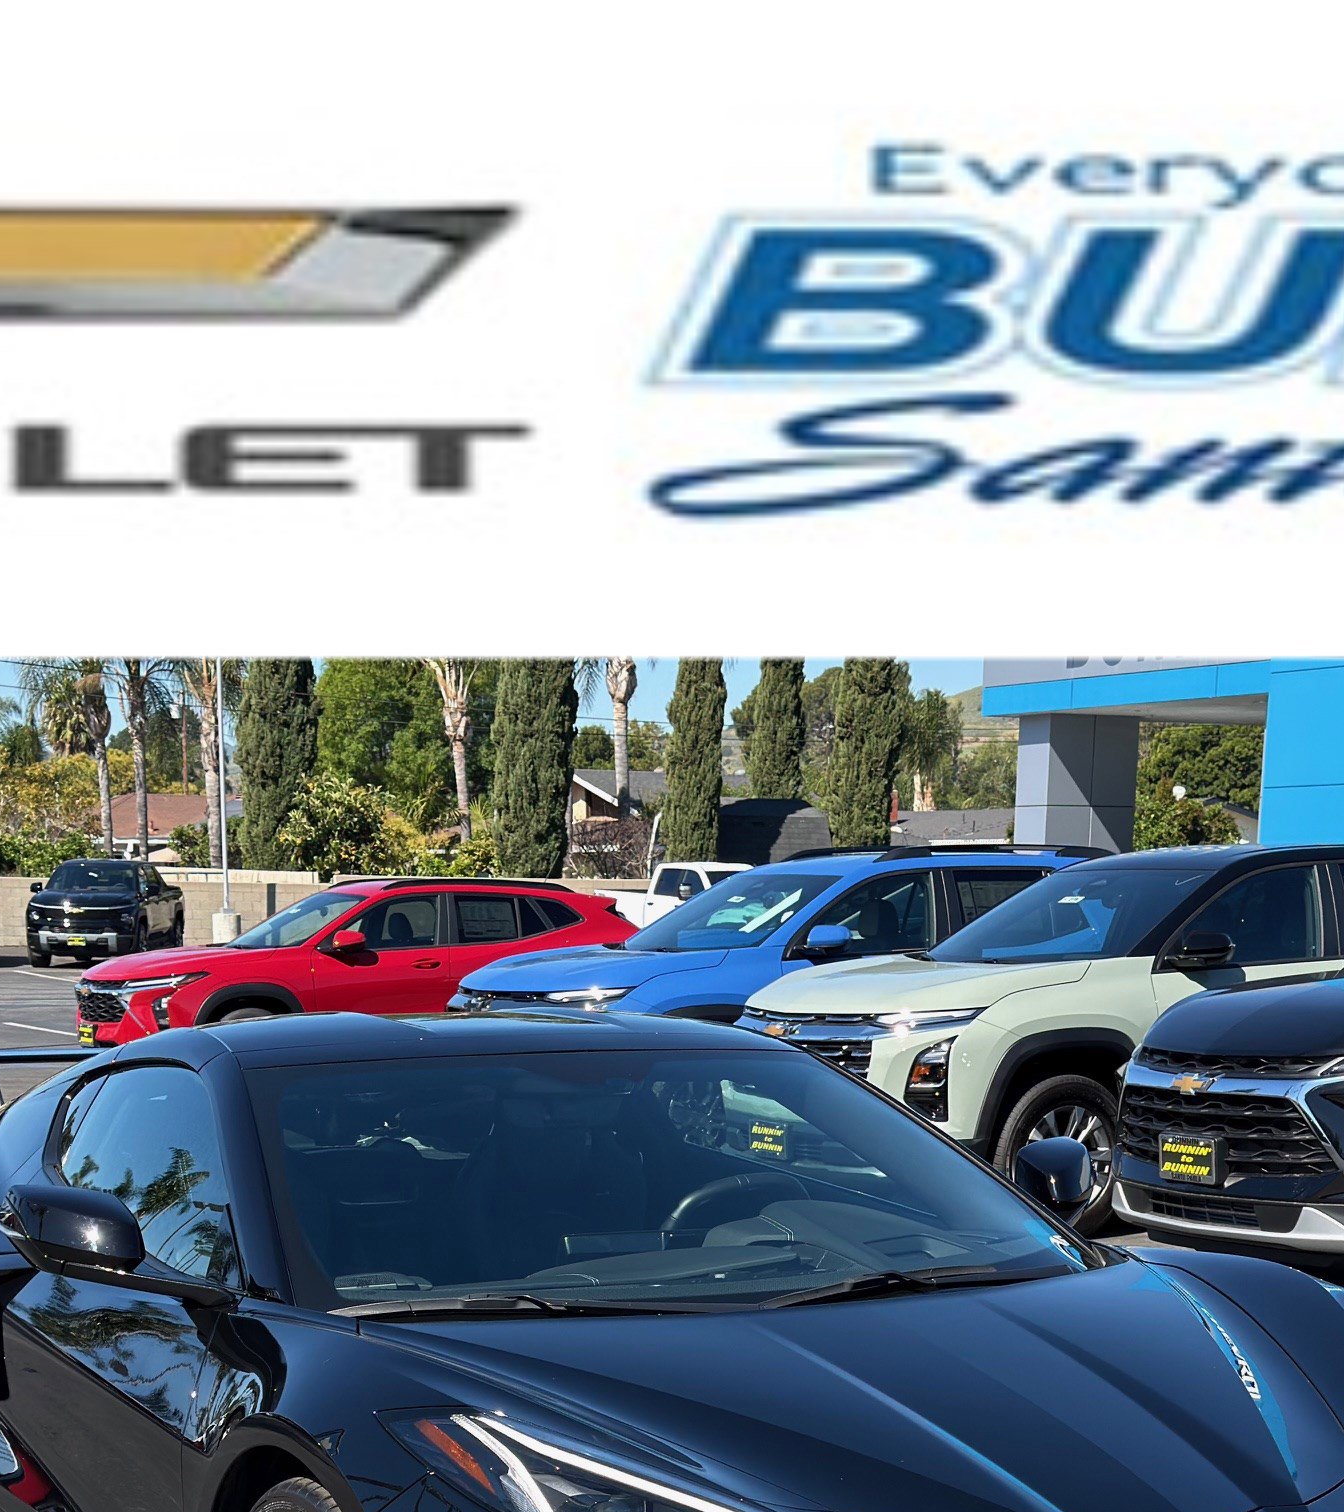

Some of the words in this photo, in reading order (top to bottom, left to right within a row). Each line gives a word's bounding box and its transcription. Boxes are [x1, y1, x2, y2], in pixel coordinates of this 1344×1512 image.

[751, 1125, 784, 1136] RUNNIN'
[751, 1140, 783, 1152] BUNNIN
[1162, 1142, 1213, 1156] RUNNIN'
[1180, 1154, 1194, 1163] to
[1162, 1161, 1210, 1176] BUNNIN
